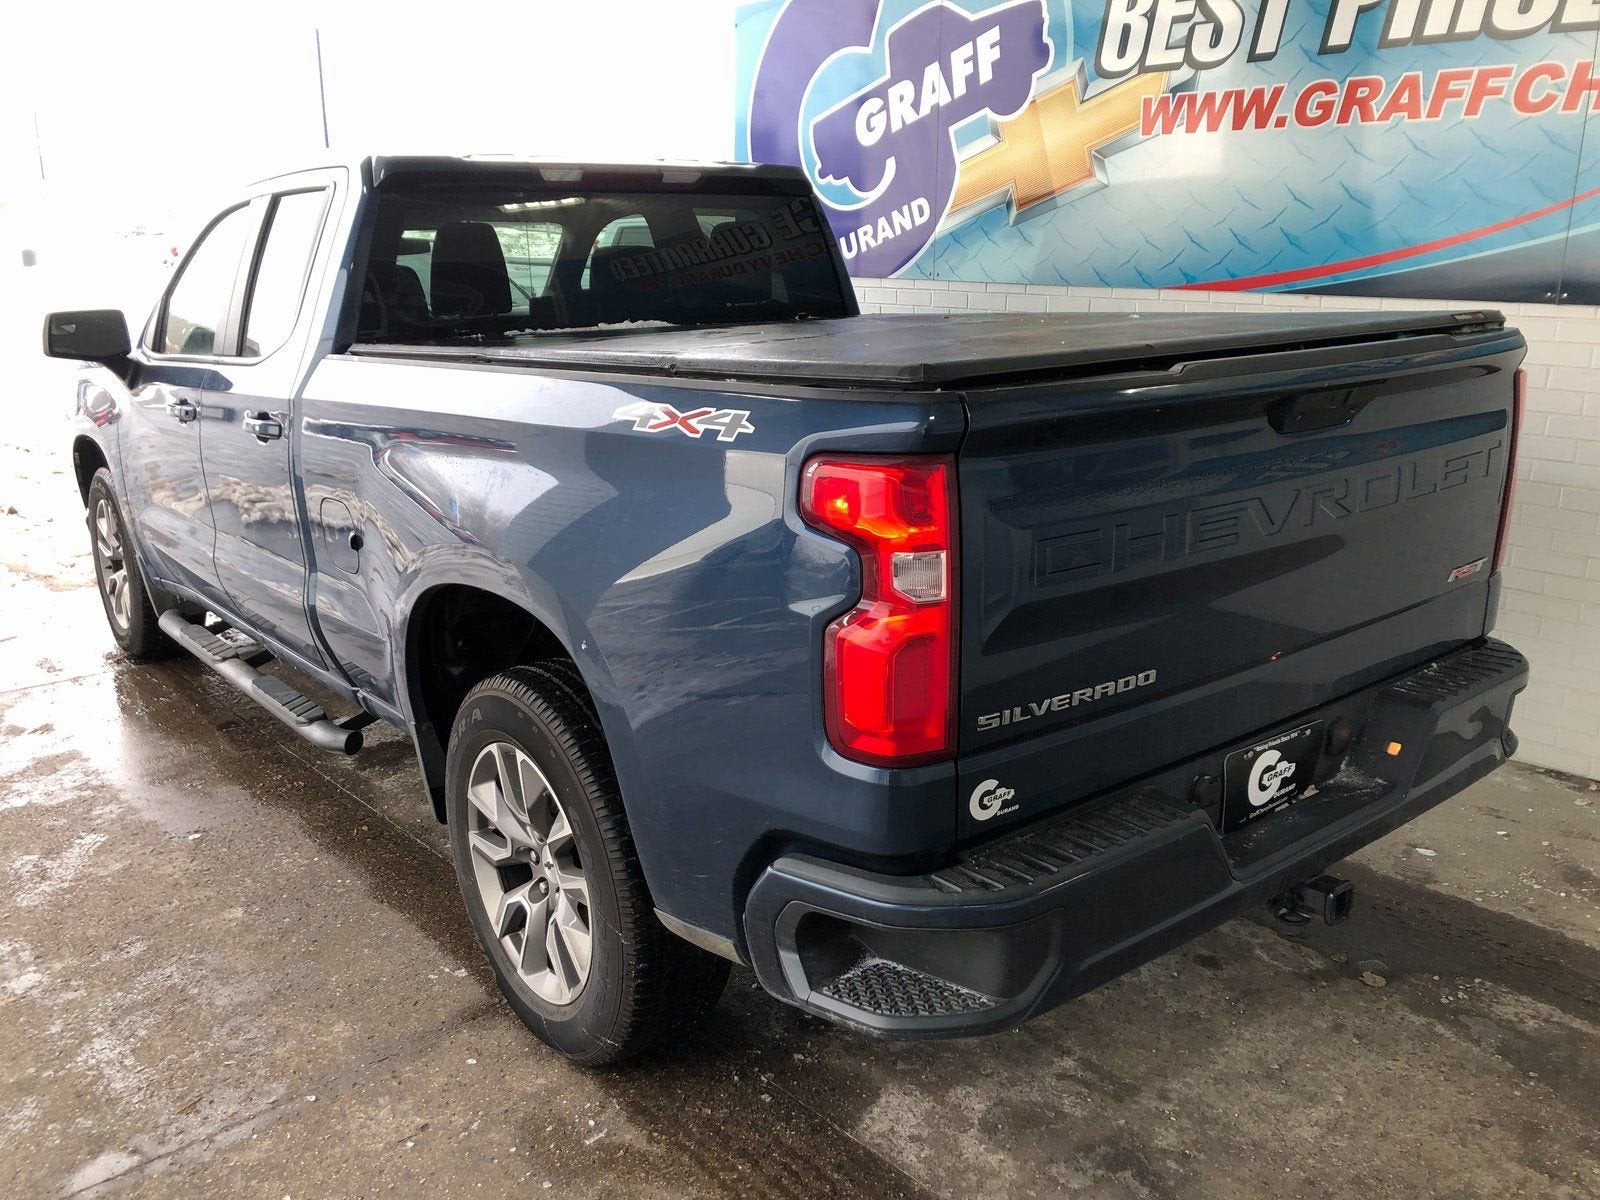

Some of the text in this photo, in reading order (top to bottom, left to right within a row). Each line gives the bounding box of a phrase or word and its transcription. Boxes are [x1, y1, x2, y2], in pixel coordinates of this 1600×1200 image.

[855, 25, 1002, 147] GRAFF
[839, 197, 931, 260] URAND
[1033, 440, 1501, 588] CHEVROLET
[977, 669, 1157, 731] SILVERADO
[987, 789, 1012, 803] GRAFF
[1266, 764, 1293, 782] GRAFF
